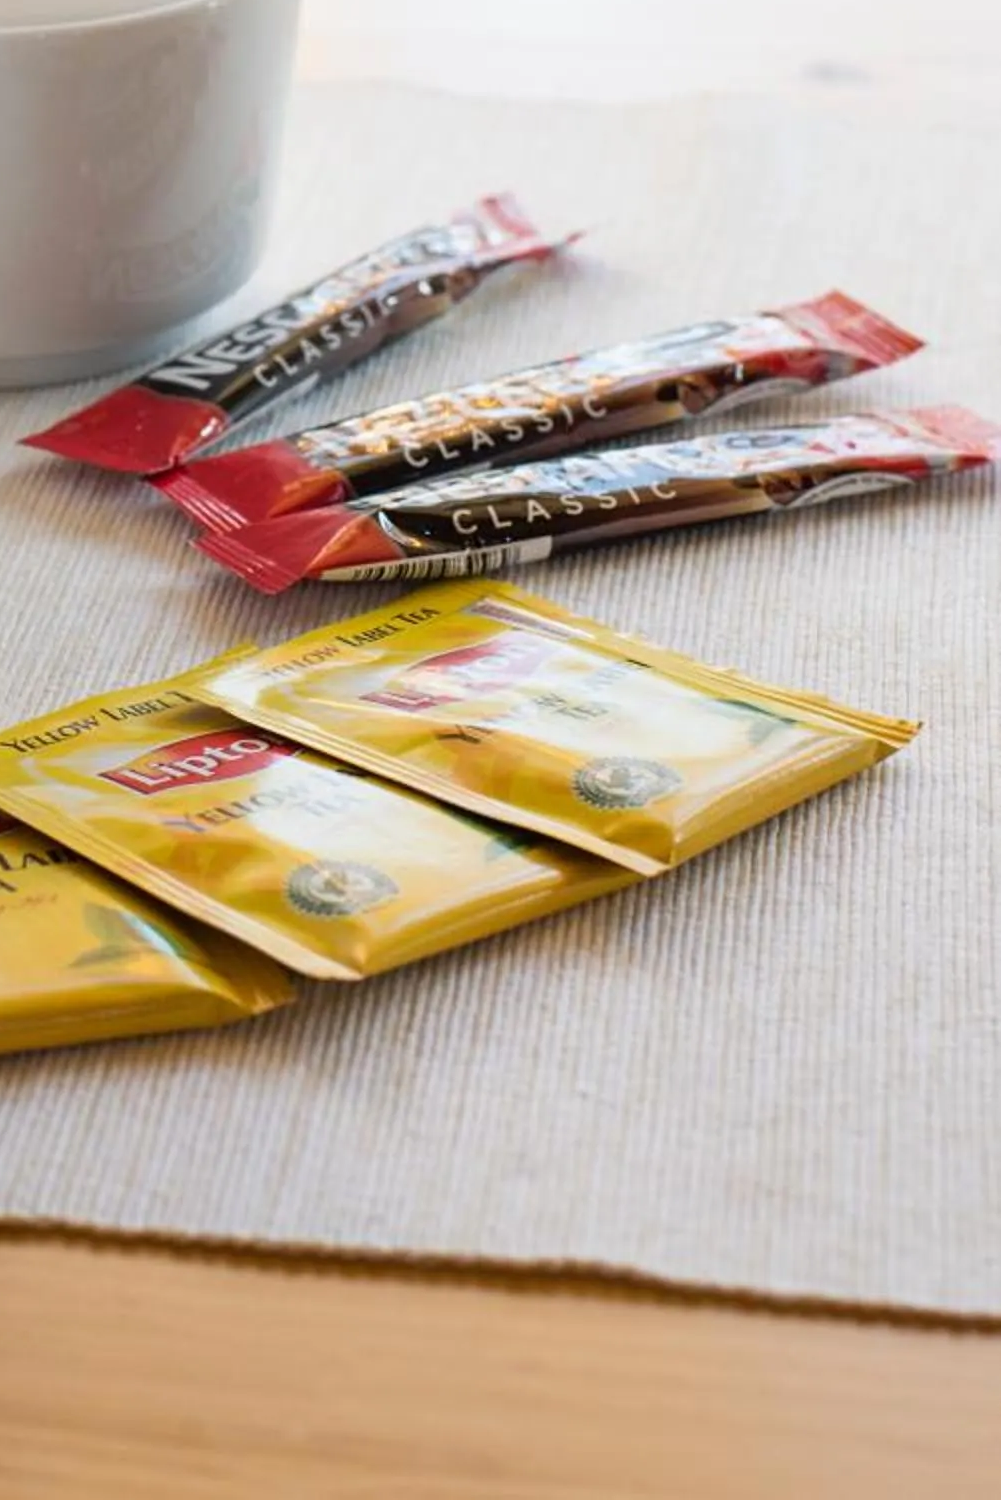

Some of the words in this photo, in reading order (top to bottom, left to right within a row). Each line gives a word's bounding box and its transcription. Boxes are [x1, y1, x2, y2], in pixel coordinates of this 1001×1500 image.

[403, 394, 607, 468] CLASSIC
[452, 479, 678, 536] CLASSIC
[336, 624, 401, 649] LABEL
[399, 606, 441, 626] TEA
[0, 716, 101, 754] YELLOW
[100, 698, 173, 723] LABEL
[119, 737, 271, 788] Lipto
